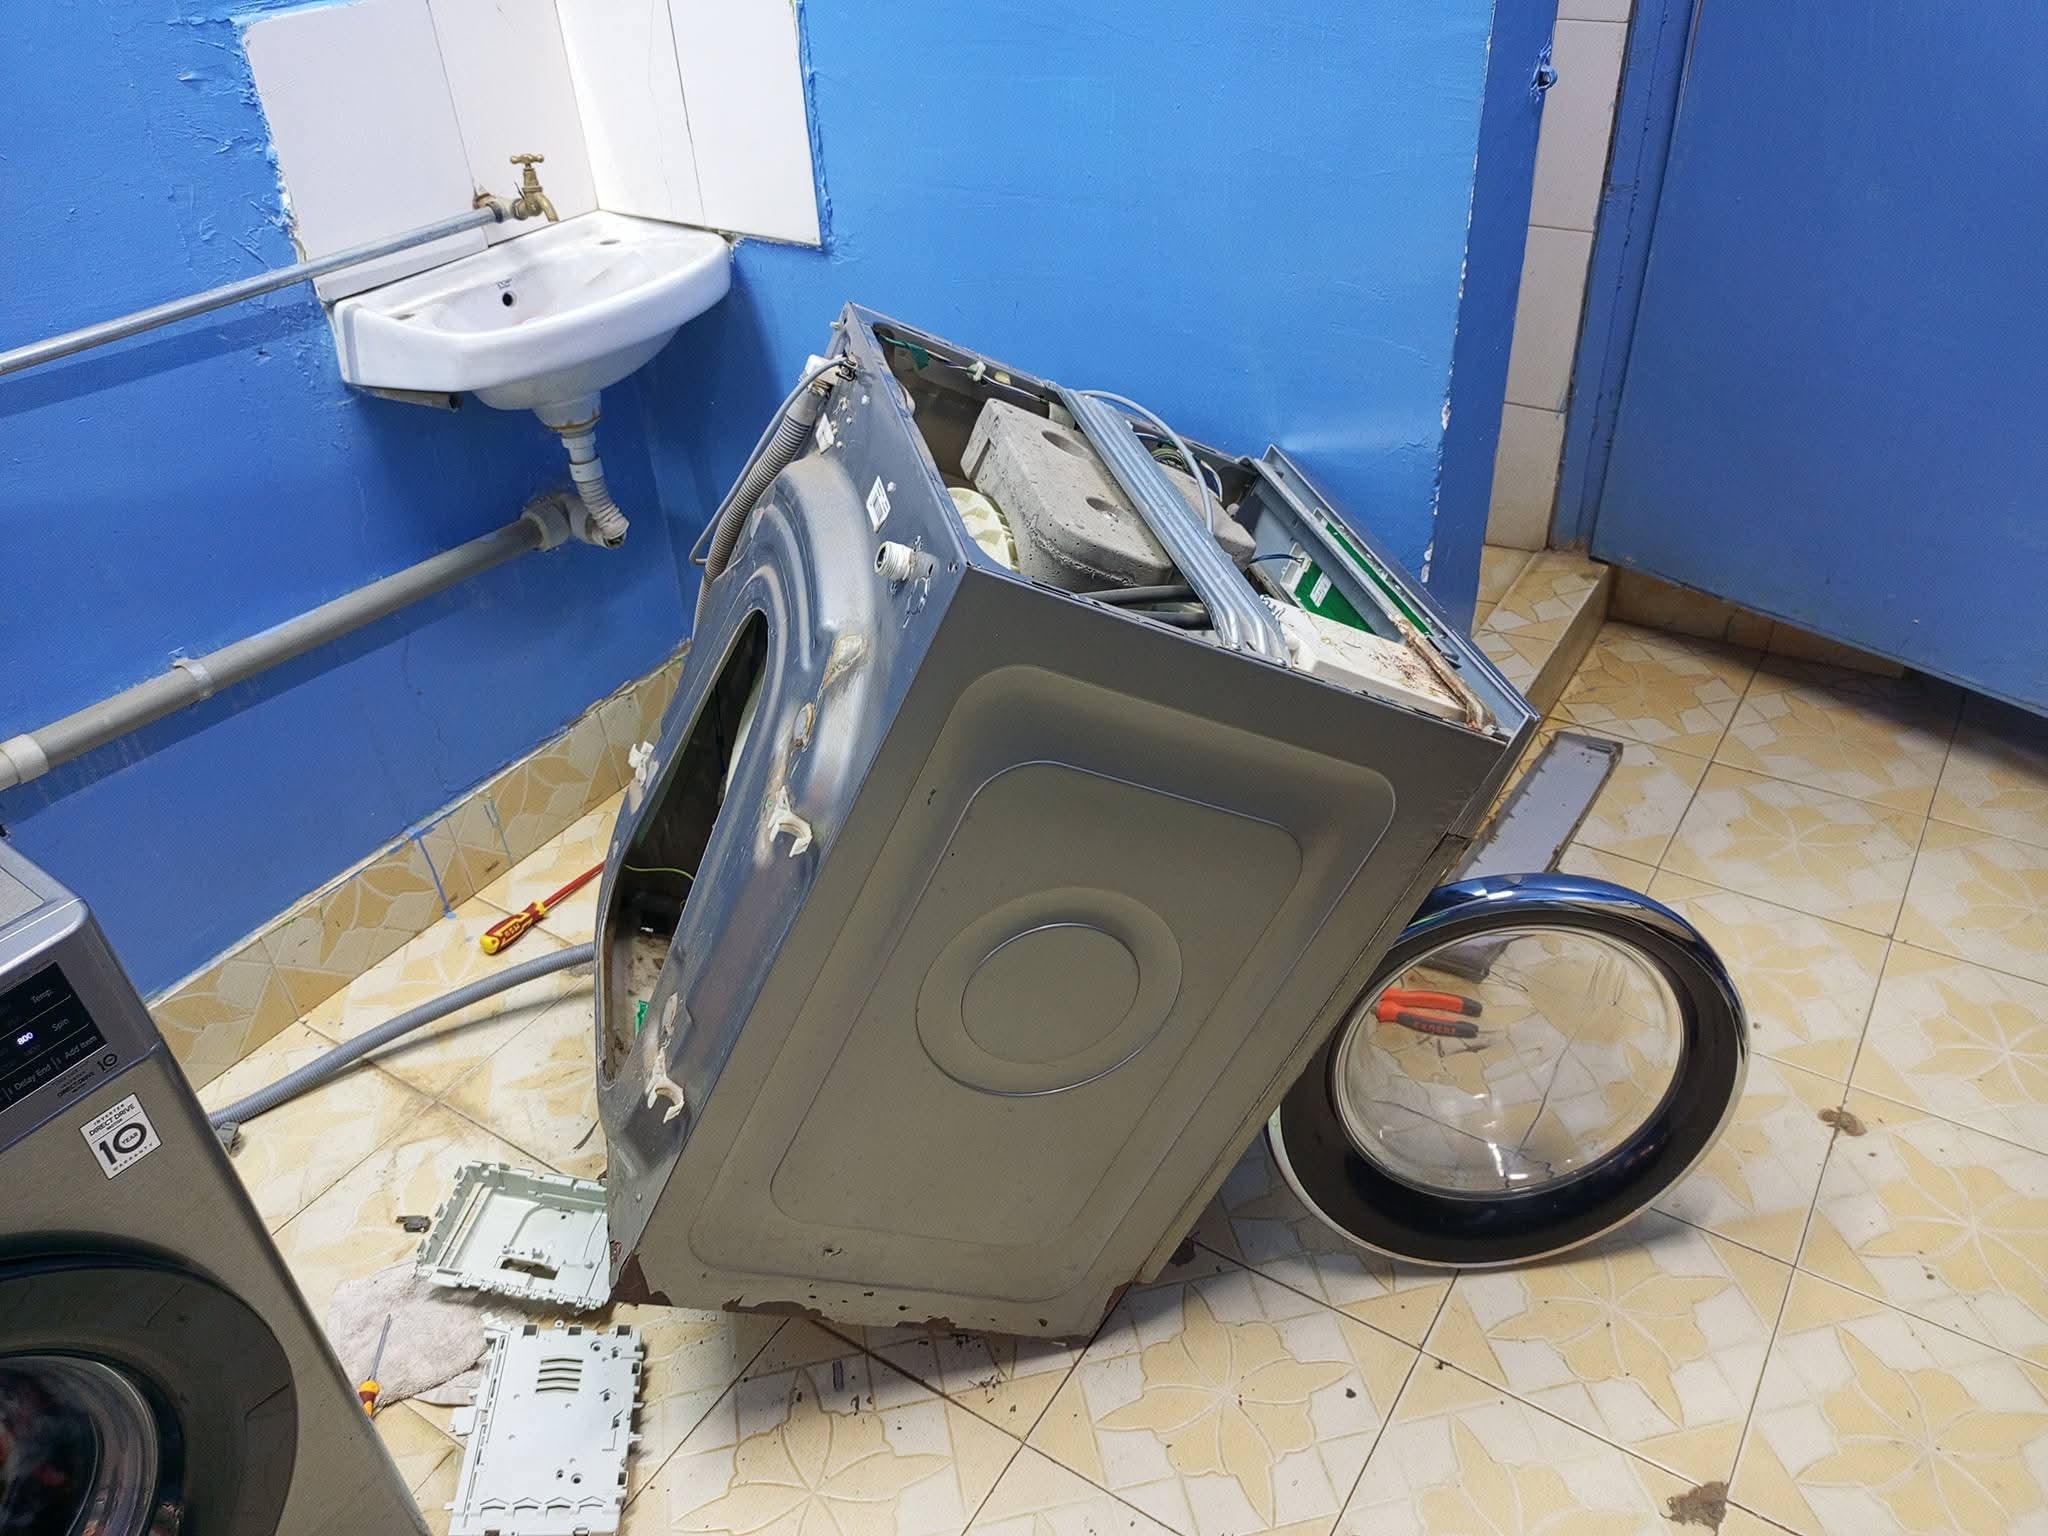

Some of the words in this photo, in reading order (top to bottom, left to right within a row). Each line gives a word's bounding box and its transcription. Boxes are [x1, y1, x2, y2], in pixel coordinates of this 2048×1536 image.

[17, 1032, 34, 1045] 800
[64, 1045, 80, 1059] Add
[89, 1116, 113, 1137] DIRECT
[114, 1103, 135, 1120] DRIVE
[98, 1122, 147, 1166] 10
[121, 1131, 139, 1145] YEAR
